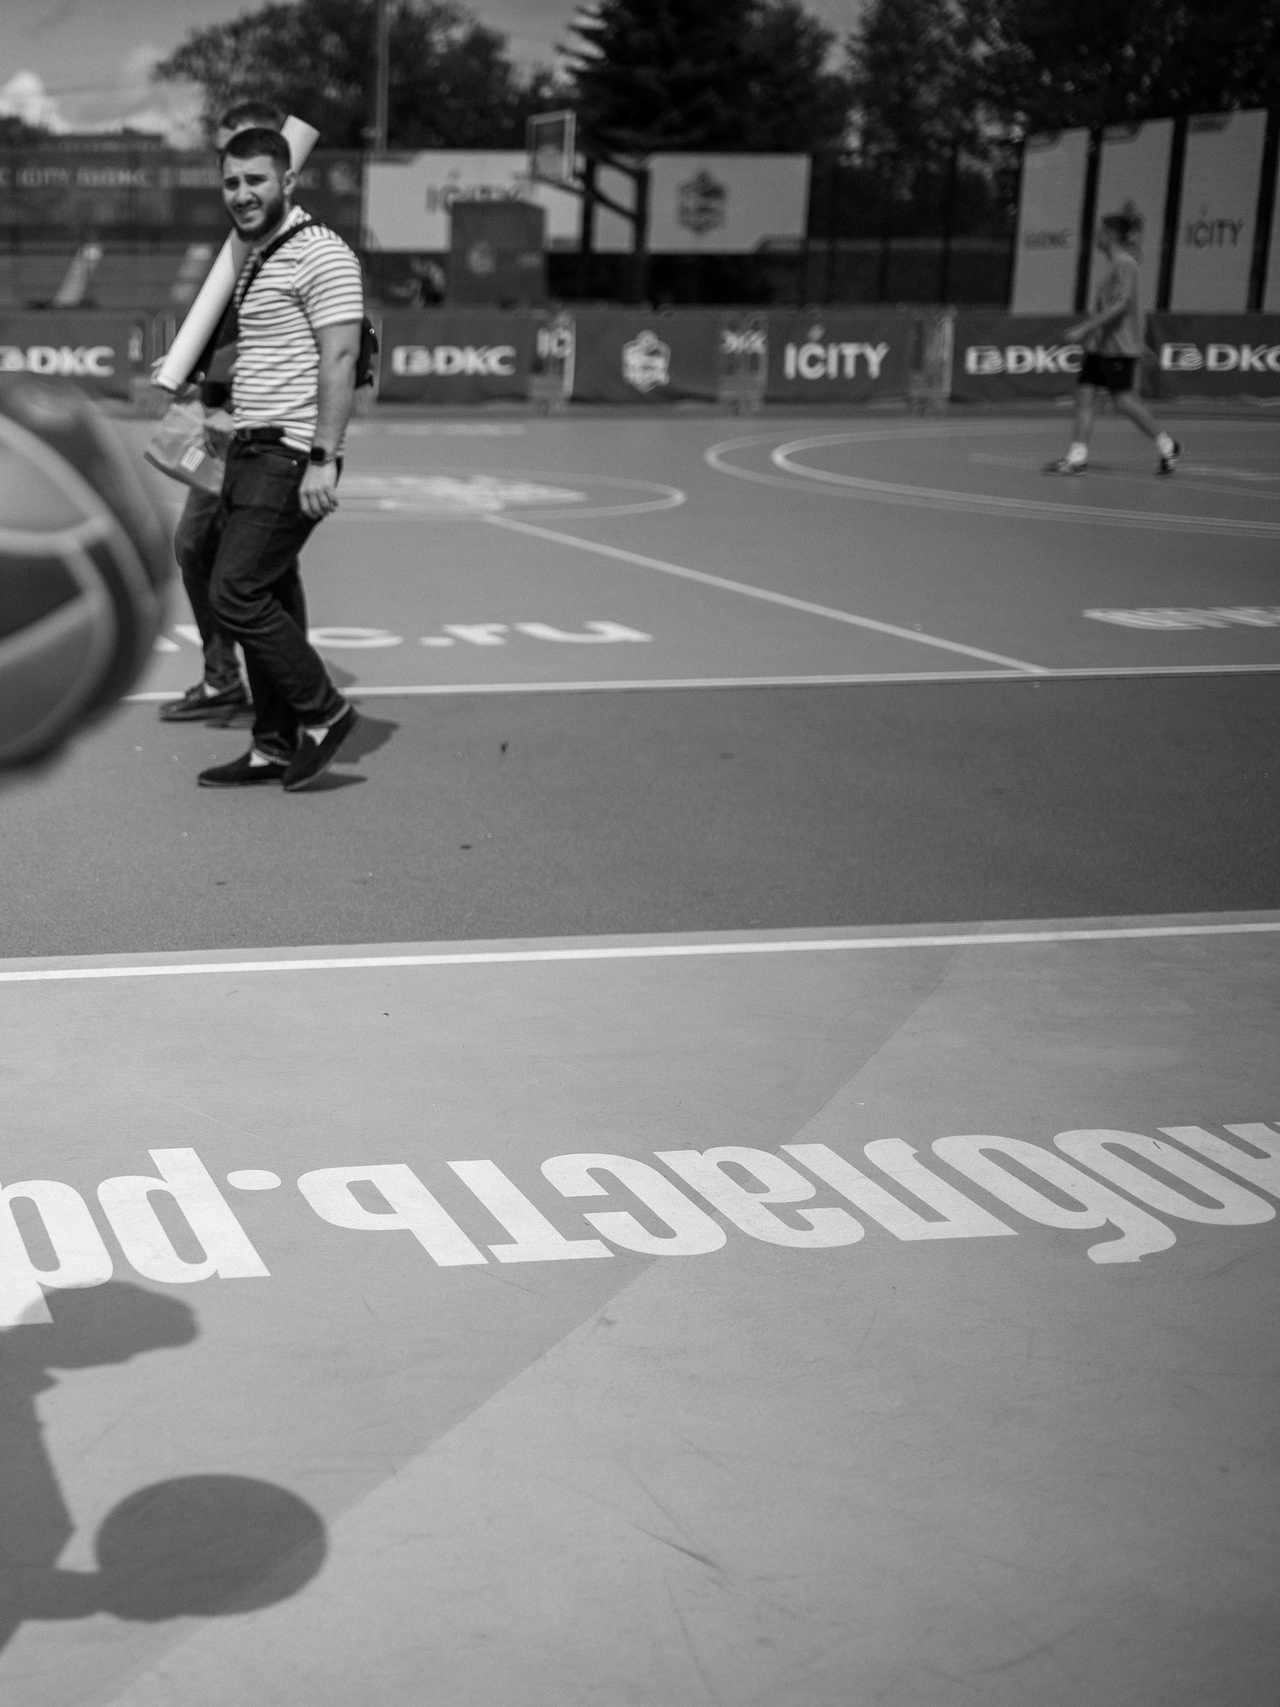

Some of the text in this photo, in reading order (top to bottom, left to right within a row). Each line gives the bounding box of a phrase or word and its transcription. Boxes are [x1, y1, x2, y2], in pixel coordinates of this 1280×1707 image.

[26, 345, 115, 378] DKC
[433, 345, 517, 376] DKC
[784, 341, 889, 380] ICITY
[1005, 344, 1084, 374] DKC
